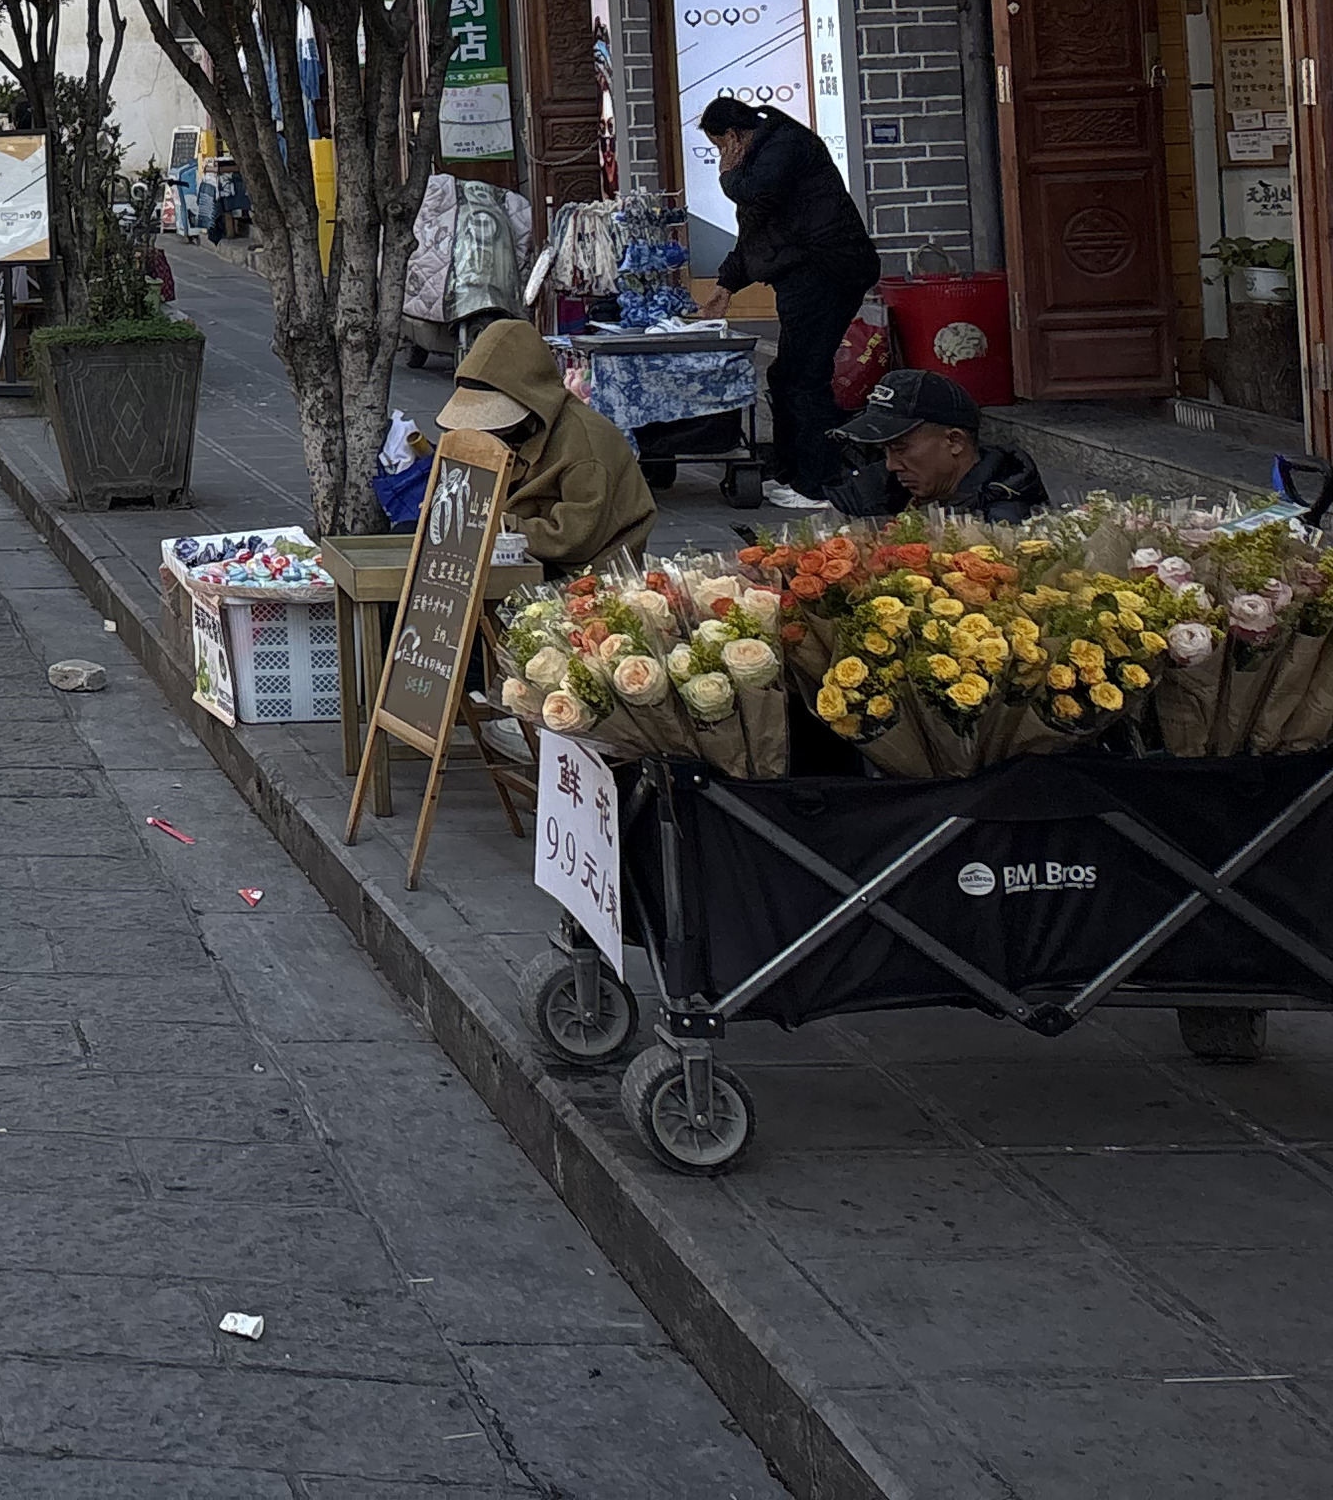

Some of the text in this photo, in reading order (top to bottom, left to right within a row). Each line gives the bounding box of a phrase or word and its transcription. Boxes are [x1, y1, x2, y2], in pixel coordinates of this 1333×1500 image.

[556, 753, 614, 848] 鲜花
[1003, 861, 1097, 888] BM Bros
